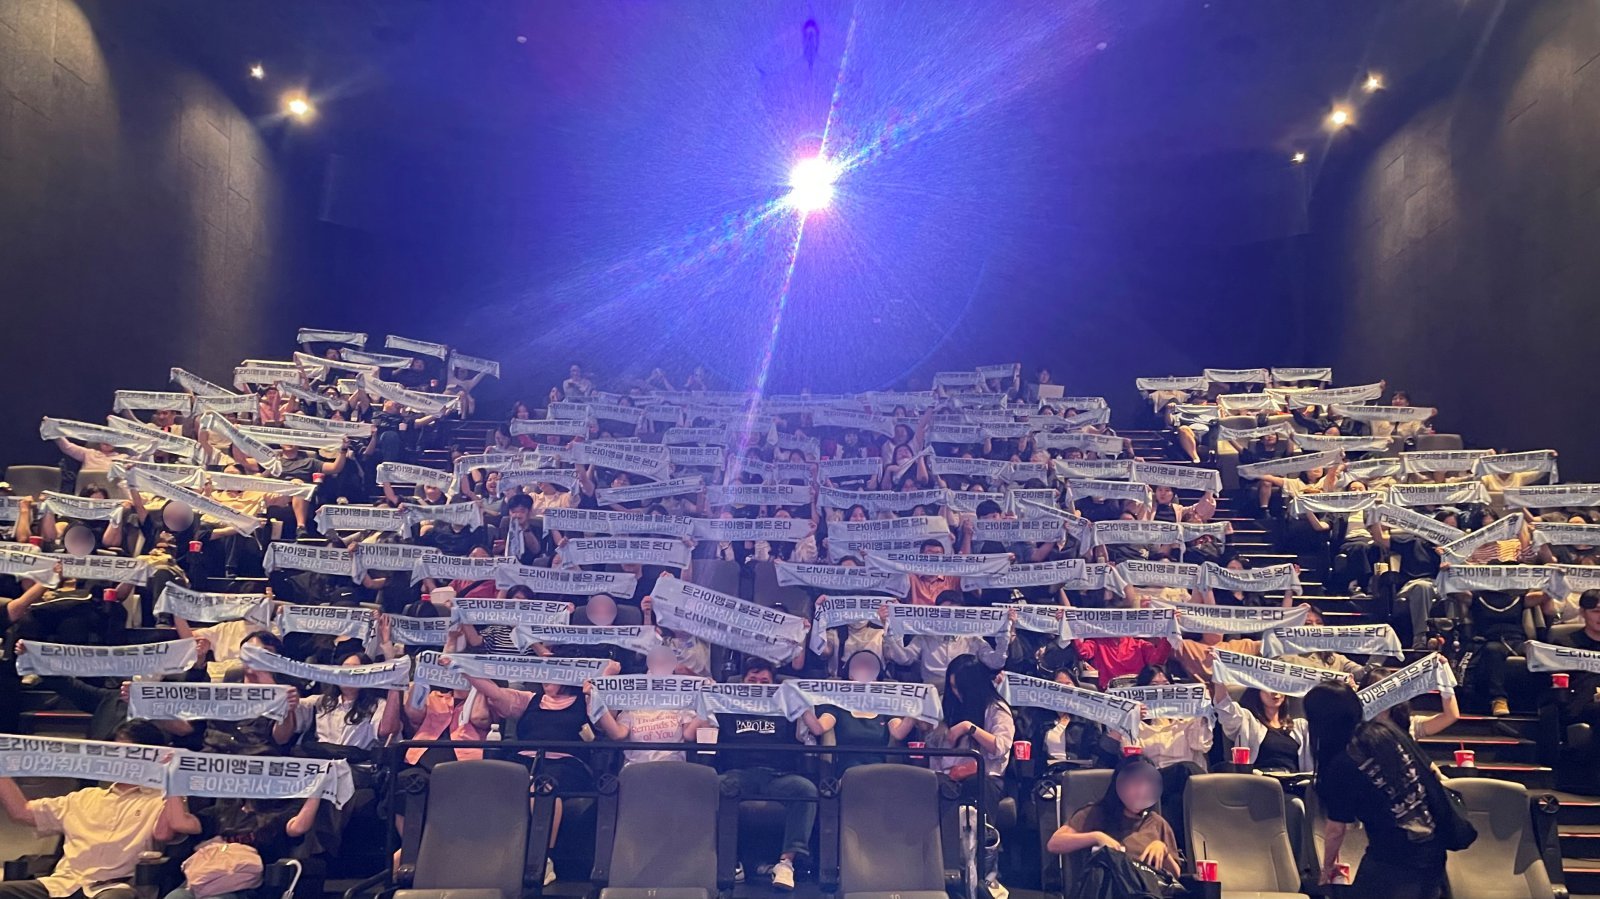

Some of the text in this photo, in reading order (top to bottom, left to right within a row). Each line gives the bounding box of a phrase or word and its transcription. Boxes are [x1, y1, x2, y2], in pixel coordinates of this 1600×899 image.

[576, 540, 627, 550] 트라이앵글
[652, 541, 672, 551] 온다
[681, 585, 737, 609] 트라이앵글
[894, 607, 1003, 621] 트라이앵글 붐은 온다
[1065, 609, 1175, 621] 트라이앵글 붐은 온다
[1274, 627, 1333, 638] 트라이앵글
[1364, 626, 1388, 638] 온다
[1218, 650, 1286, 674] 트라이앵글
[417, 666, 468, 687] 아와줘서
[483, 663, 592, 683] 돌아와줘서 고마워
[651, 679, 677, 692] 붐은
[870, 683, 897, 695] 붐은
[900, 684, 929, 699] 온다
[1008, 675, 1073, 695] 트라이앵글
[142, 686, 277, 701] 트라이앵글 붐은 온다
[1162, 688, 1186, 700] 붐은
[656, 730, 675, 741] You
[6, 753, 145, 779] 돌아와줘서 고마워
[179, 756, 264, 775] 트라이앵글
[268, 761, 301, 778] 붐은
[189, 775, 272, 796] 돌아와줘서
